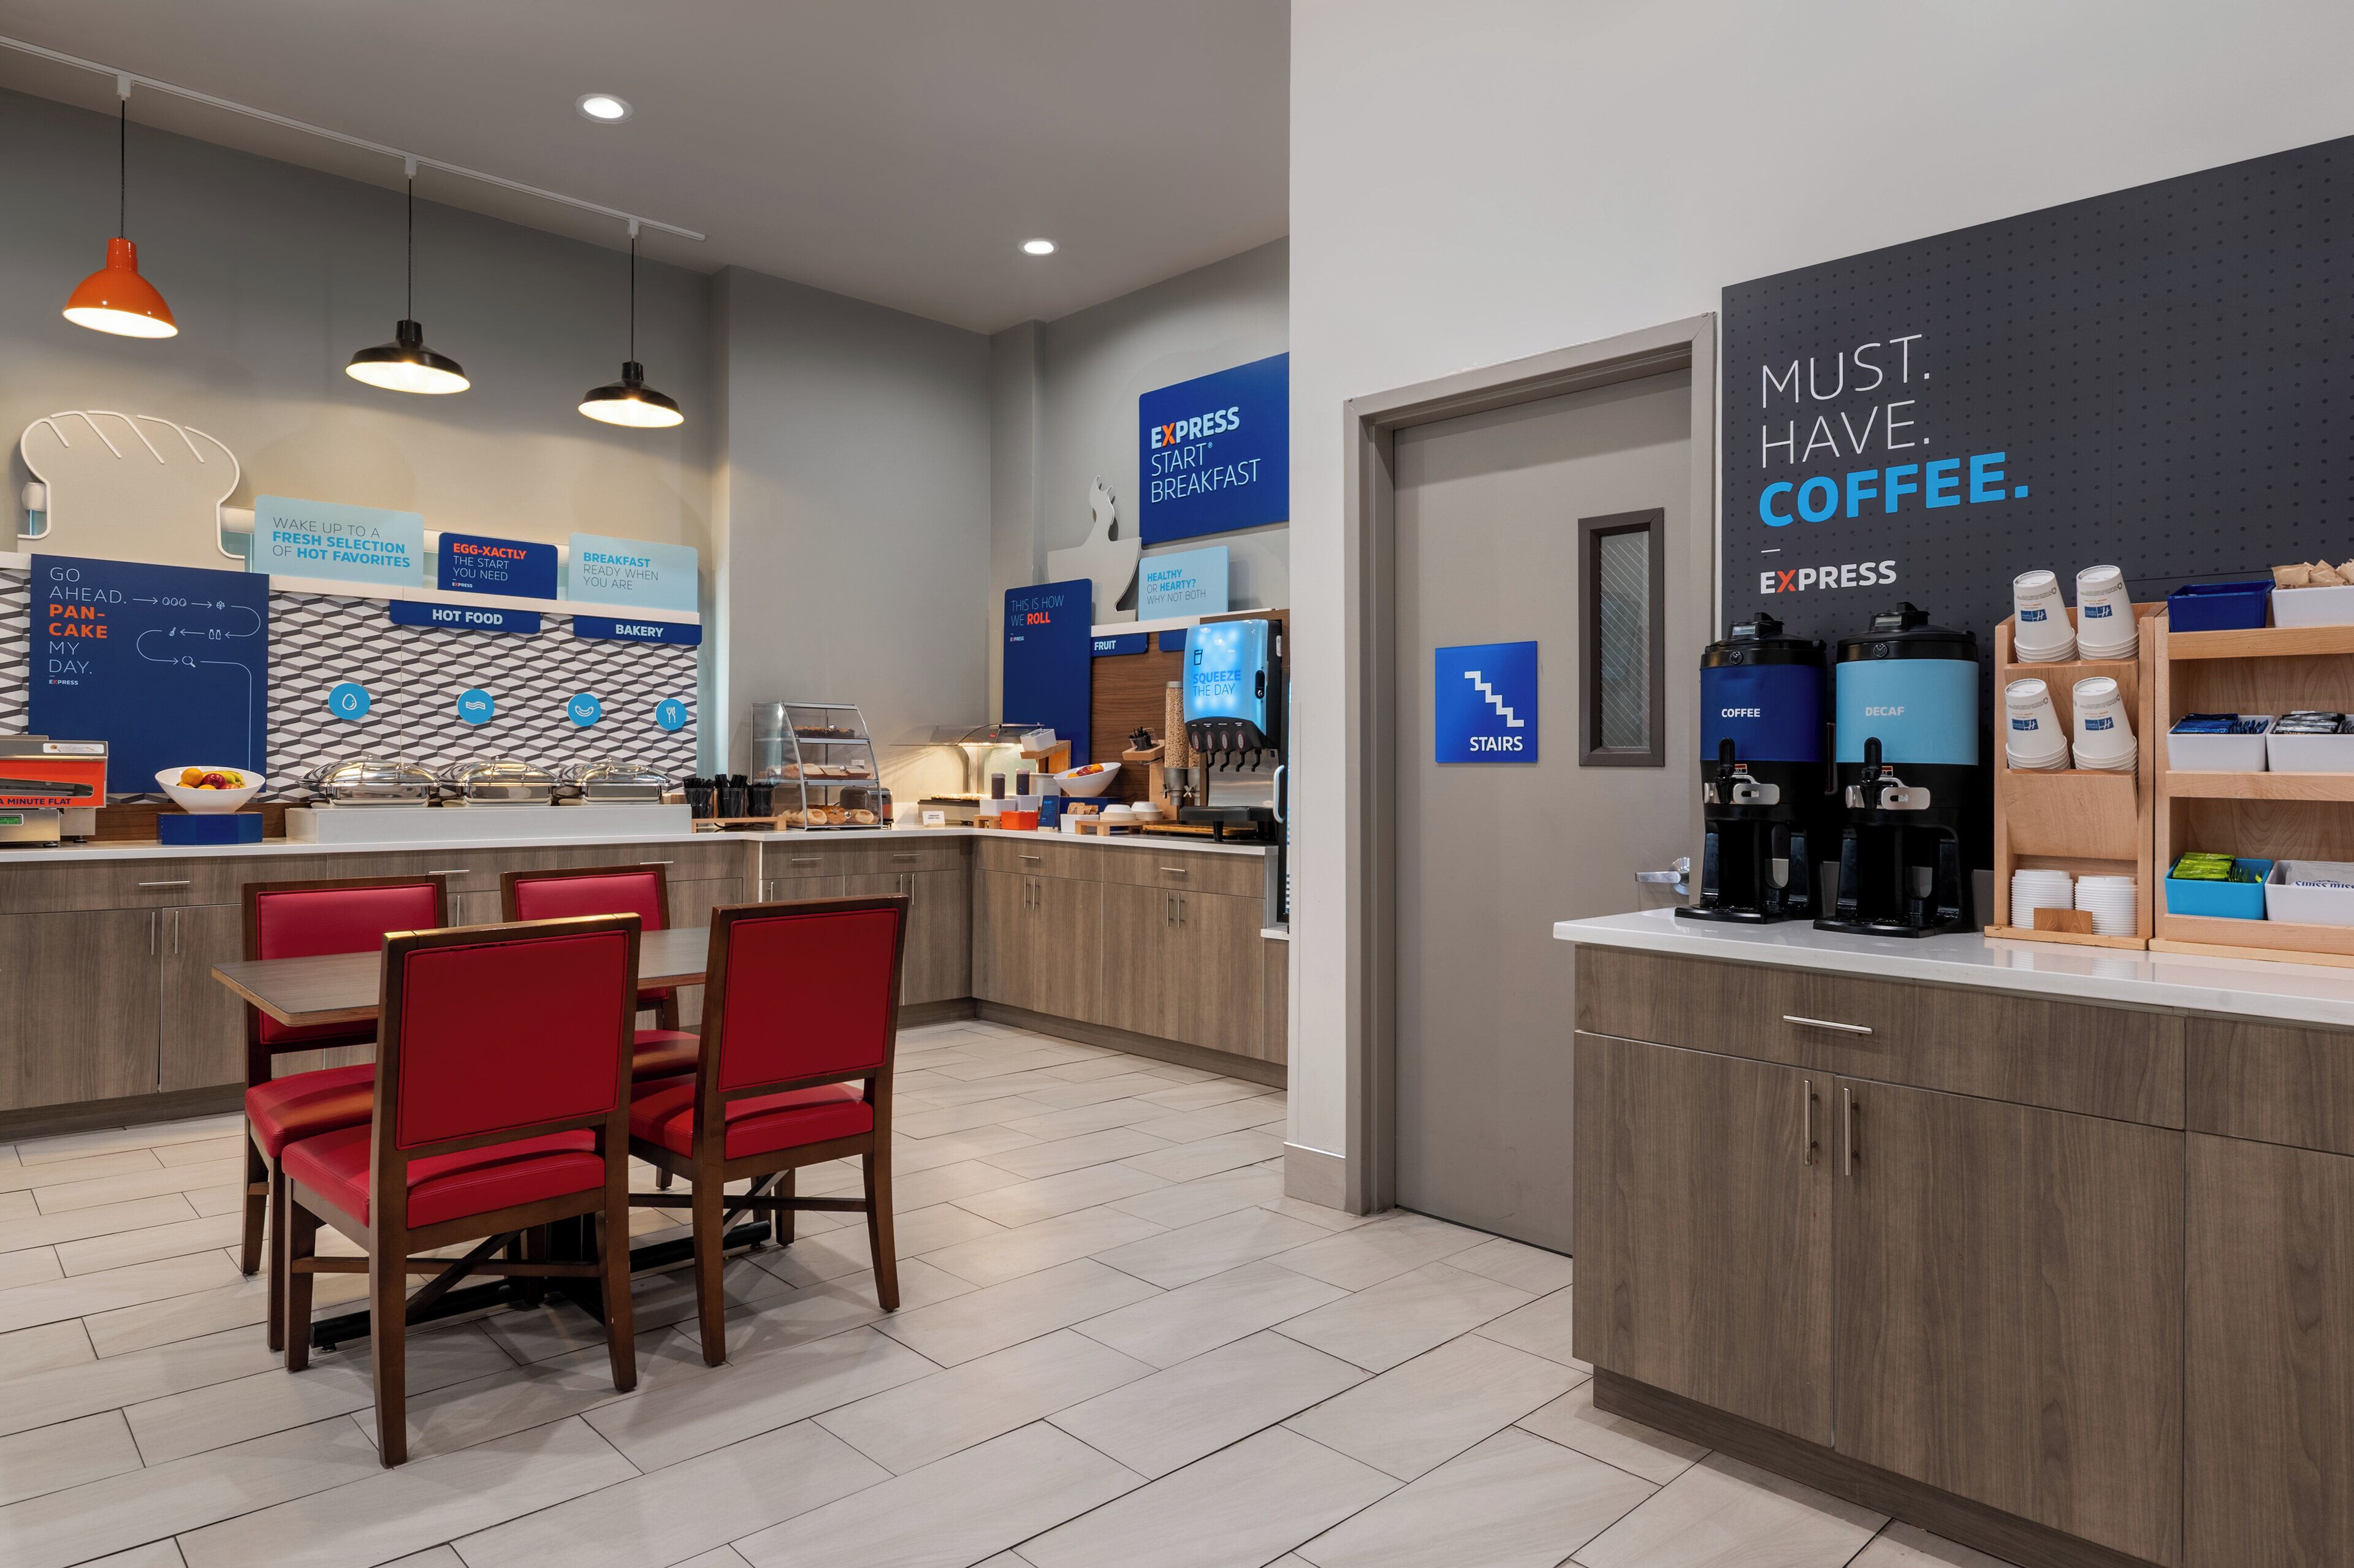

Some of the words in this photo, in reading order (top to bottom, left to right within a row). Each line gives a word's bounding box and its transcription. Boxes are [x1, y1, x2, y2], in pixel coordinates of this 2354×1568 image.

[1762, 333, 1930, 408] MUST.
[1151, 406, 1240, 449] EXPRESS
[1762, 400, 1930, 468] HAVE.
[1151, 459, 1261, 503] BREAKFAST
[1759, 451, 2028, 527] COFFEE.
[273, 517, 317, 532] WAKE
[322, 522, 341, 534] UP
[347, 525, 366, 537] TO
[370, 528, 380, 539] A
[273, 531, 321, 546] FRESH
[327, 536, 405, 554] SELECTION
[273, 545, 292, 557] OF
[297, 547, 328, 561] HOT
[332, 550, 410, 568] FAVORITES
[453, 543, 527, 560] EGG-XACTLY
[453, 555, 474, 566] THE
[478, 558, 509, 569] START
[584, 552, 650, 568] BREAKFAST
[50, 567, 80, 582] GO
[453, 567, 476, 578] YOU
[480, 570, 508, 581] NEED
[584, 564, 620, 576] READY
[625, 568, 658, 580] WHEN
[1147, 569, 1182, 582] HEALTHY
[1760, 559, 1897, 595] EXPRESS
[583, 576, 607, 588] YOU
[611, 579, 633, 590] ARE
[1147, 584, 1157, 593] OR
[1160, 579, 1196, 592] HEARTY?
[50, 586, 126, 604] AHEAD.
[1147, 594, 1165, 604] WHY
[1167, 592, 1183, 603] NOT
[1185, 588, 1206, 600] BOTH
[49, 604, 105, 619] PAN-
[1011, 598, 1029, 612] THIS
[1032, 597, 1039, 610] IS
[1042, 595, 1064, 609] HOW
[432, 609, 461, 622] HOT
[465, 612, 503, 625] FOOD
[1011, 614, 1024, 627] WE
[1027, 612, 1051, 625] ROLL
[49, 623, 107, 639] CAKE
[615, 624, 664, 637] BAKERY
[50, 641, 80, 655] MY
[1094, 640, 1116, 651] FRUIT
[49, 659, 92, 674] DAY.
[1193, 670, 1241, 684] SQUEEZE
[1192, 685, 1211, 697] THE
[1214, 683, 1235, 696] DAY
[1721, 708, 1761, 718] COFFEE
[1865, 706, 1905, 717] DECAF
[1469, 736, 1523, 752] STAIRS
